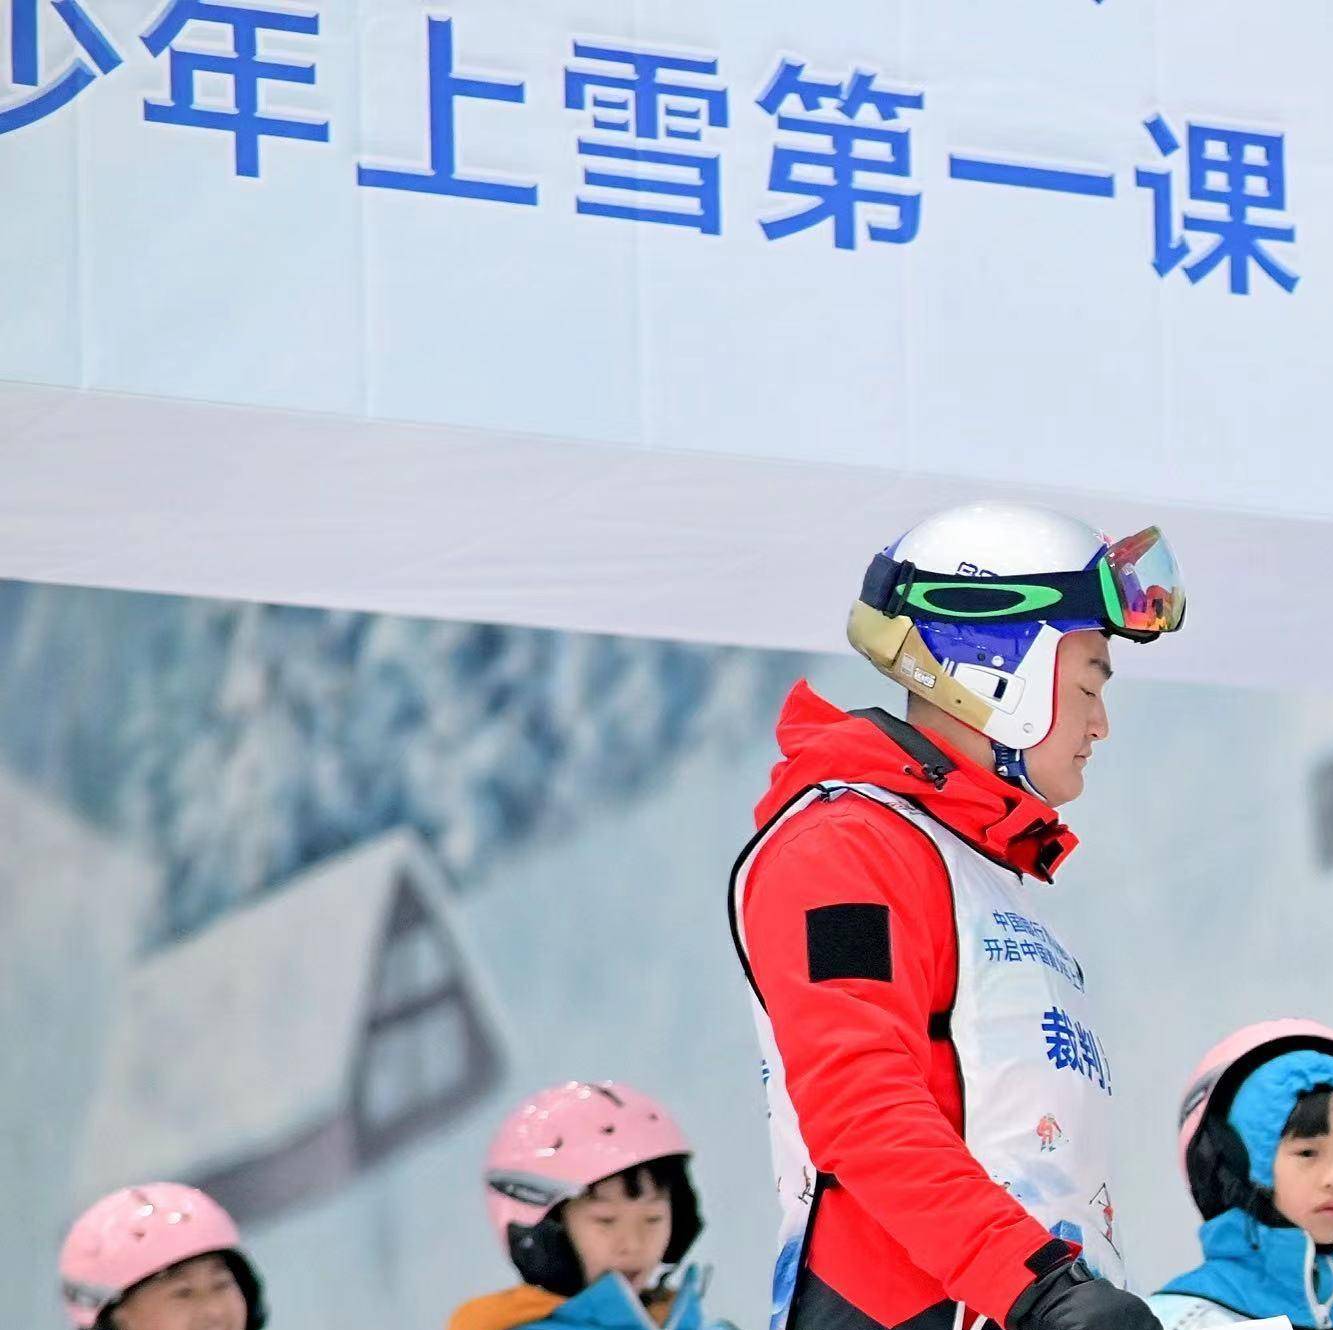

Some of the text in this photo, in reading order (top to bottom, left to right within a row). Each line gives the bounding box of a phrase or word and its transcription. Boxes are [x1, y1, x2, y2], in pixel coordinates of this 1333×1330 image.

[0, 0, 1302, 296] 少年上雪第一课
